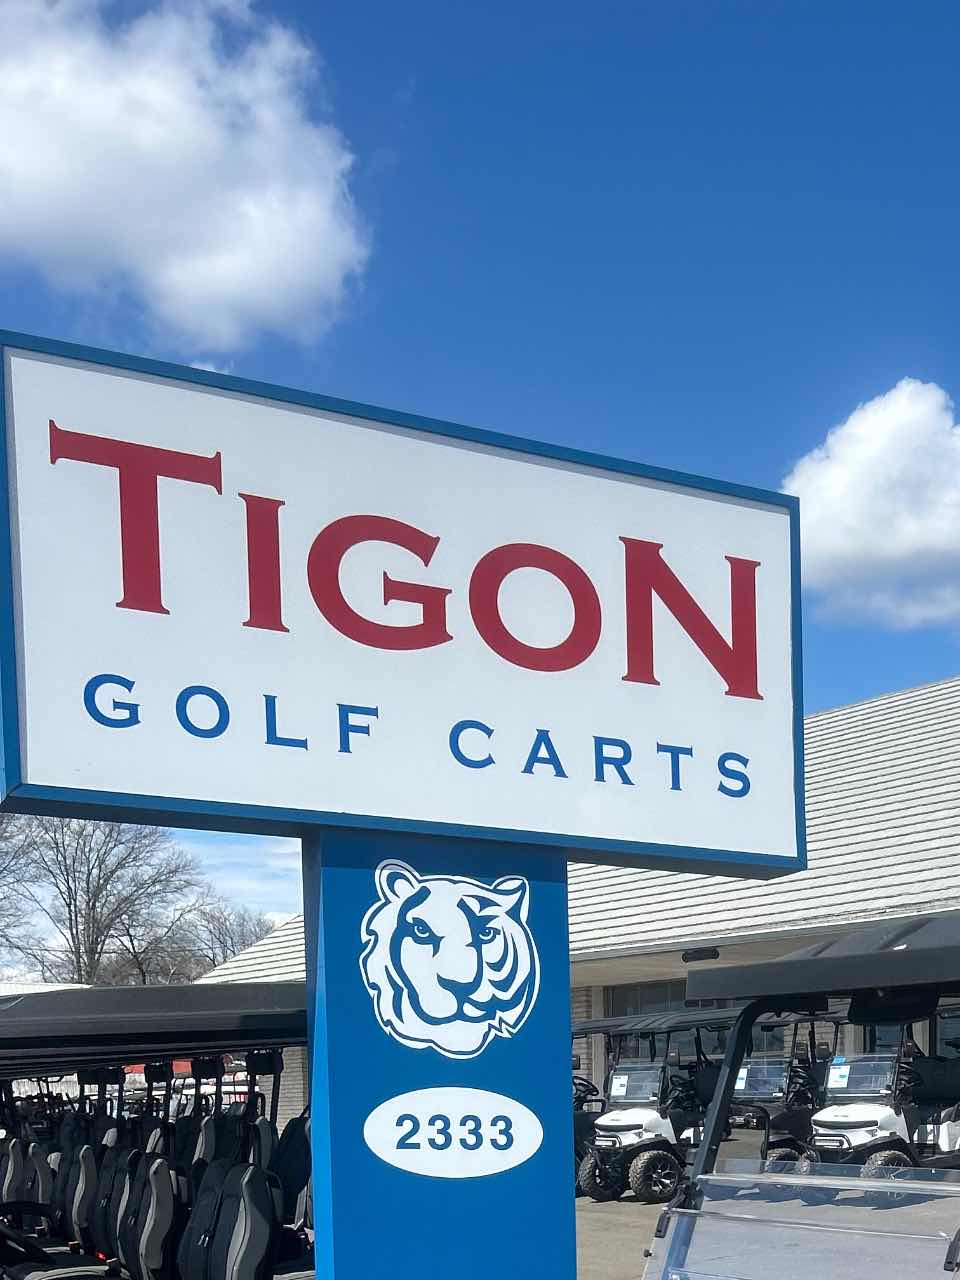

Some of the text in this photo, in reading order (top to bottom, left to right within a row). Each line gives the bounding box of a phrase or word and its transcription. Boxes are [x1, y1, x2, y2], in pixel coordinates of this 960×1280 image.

[49, 419, 764, 701] TIGON
[83, 673, 751, 798] GOLF CARTS
[395, 1113, 514, 1151] 2333
